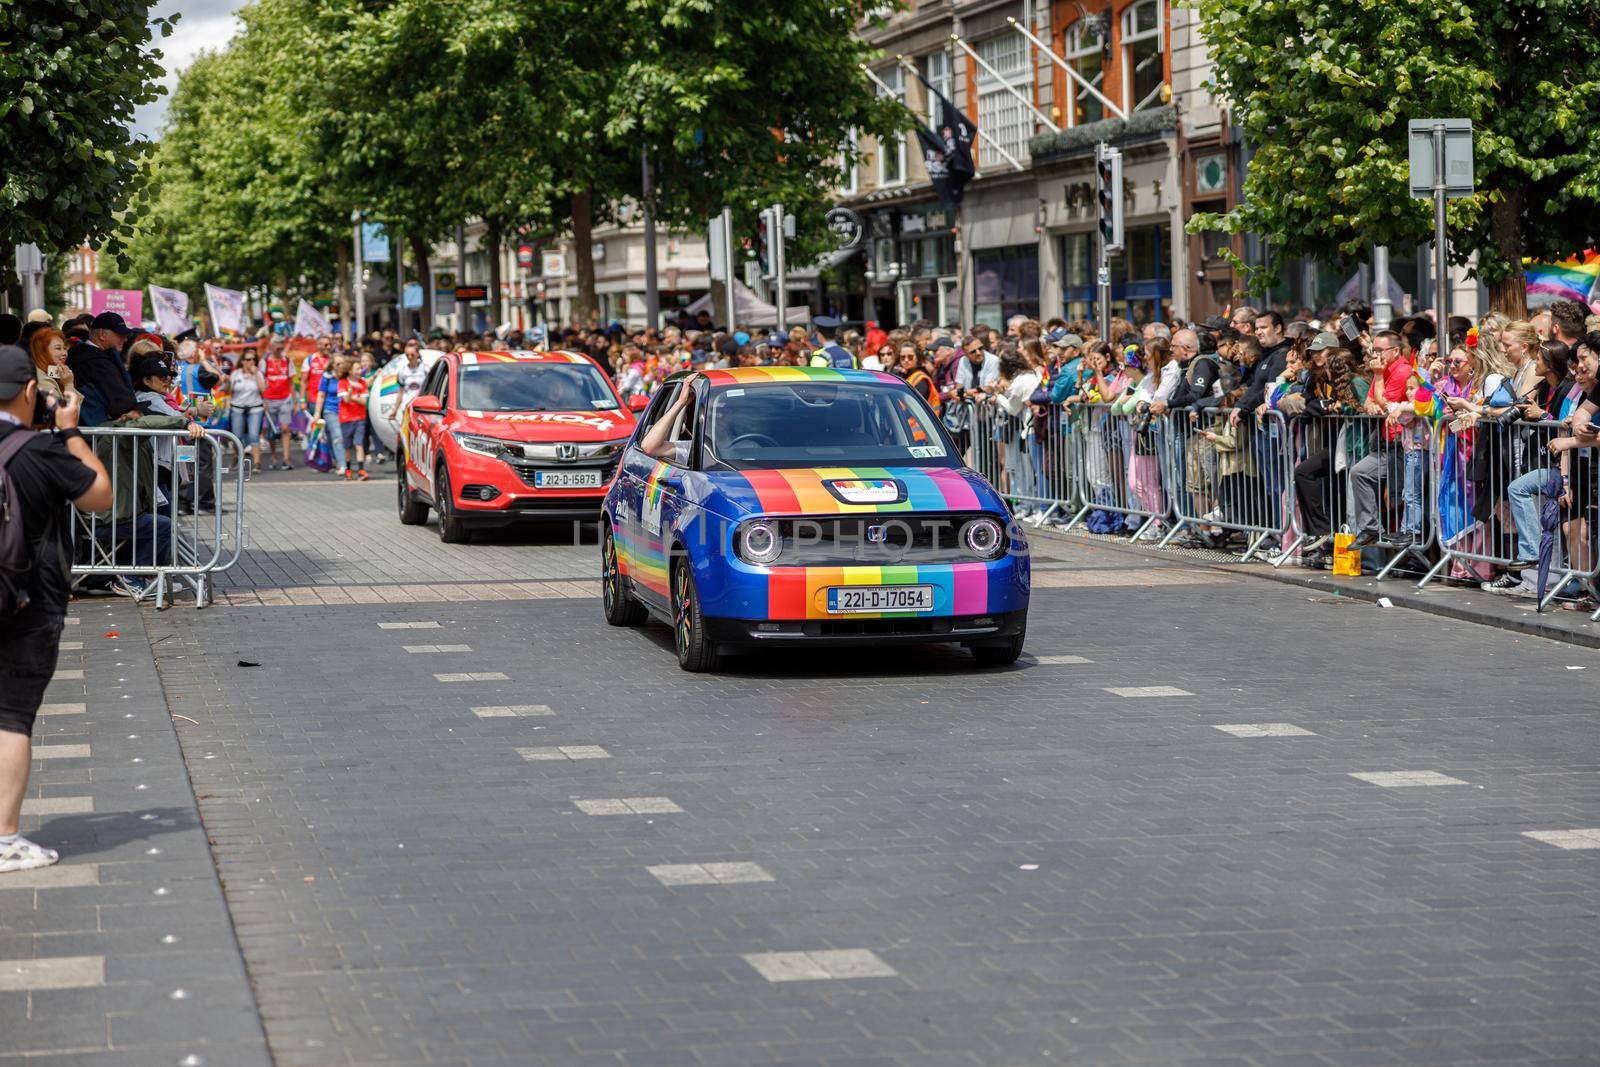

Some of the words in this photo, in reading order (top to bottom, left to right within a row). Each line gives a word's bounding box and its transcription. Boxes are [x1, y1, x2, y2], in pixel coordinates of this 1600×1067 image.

[494, 413, 614, 431] FM104
[546, 475, 596, 485] 212-D-15879
[844, 591, 924, 607] 221-D-17054
